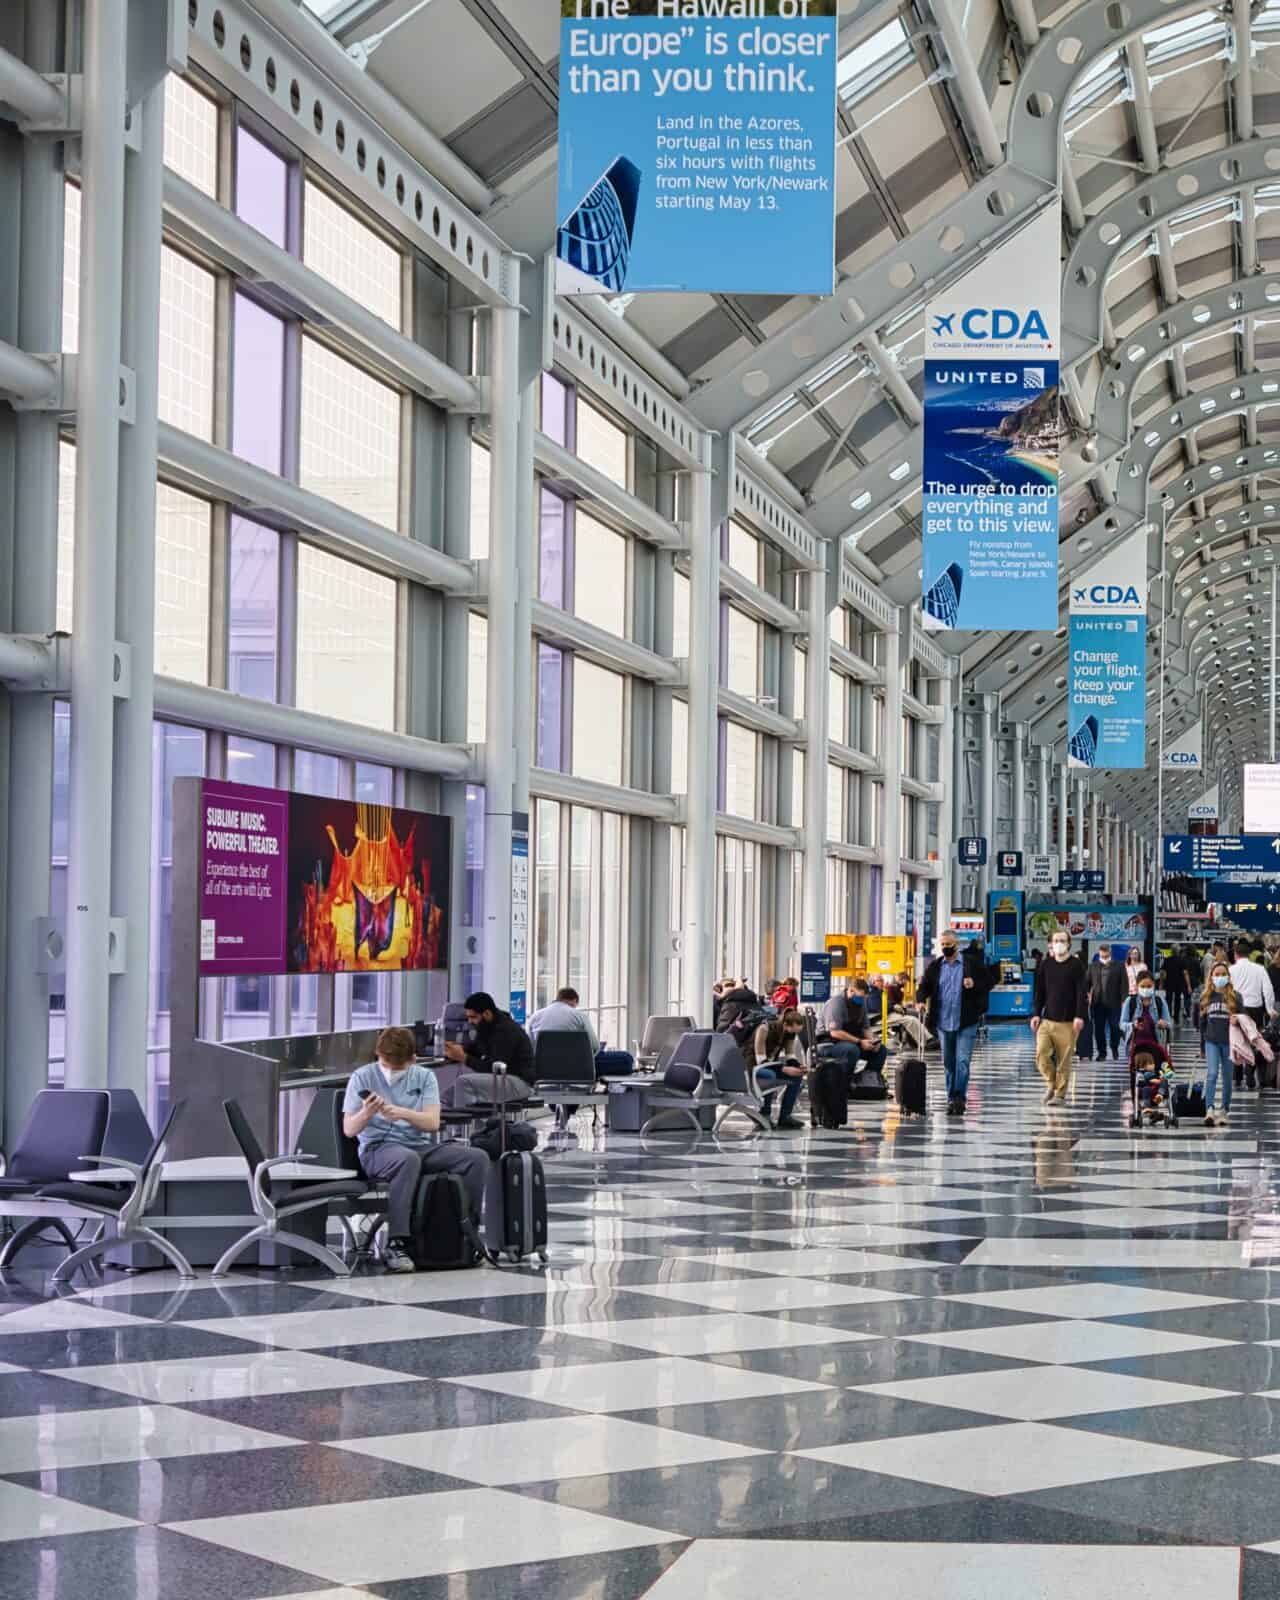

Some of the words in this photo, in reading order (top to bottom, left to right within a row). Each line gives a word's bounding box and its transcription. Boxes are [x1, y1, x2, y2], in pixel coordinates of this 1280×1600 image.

[705, 25, 728, 56] is
[738, 26, 830, 56] closer
[568, 64, 641, 93] than
[652, 67, 713, 96] you
[724, 62, 815, 93] think.
[656, 115, 694, 130] Land
[699, 115, 713, 130] in
[719, 115, 743, 130] the
[747, 115, 804, 132] Azores,
[656, 135, 721, 152] Portugal
[726, 135, 740, 149] in
[745, 135, 774, 150] less
[779, 136, 813, 150] than
[656, 155, 677, 170] six
[682, 155, 726, 170] hours
[731, 156, 763, 170] with
[769, 155, 816, 172] flights
[656, 175, 691, 189] from
[695, 176, 728, 190] New
[732, 175, 829, 191] York/Newark
[655, 195, 714, 210] starting
[719, 196, 751, 211] May
[758, 196, 779, 210] 13.
[961, 308, 1049, 340] CDA
[935, 372, 1018, 383] UNITED
[927, 481, 956, 497] The
[960, 485, 995, 498] urge
[1000, 483, 1016, 497] to
[1020, 482, 1057, 498] drop
[927, 499, 1014, 516] everything
[1018, 500, 1047, 514] and
[927, 518, 952, 534] get
[957, 518, 973, 532] to
[979, 518, 1008, 532] this
[1012, 518, 1055, 532] view.
[1090, 585, 1139, 604] CDA
[1073, 650, 1118, 664] Change
[1073, 665, 1102, 677] your
[1106, 664, 1141, 678] flight.
[1073, 680, 1103, 692] Keep
[1107, 681, 1135, 693] your
[1073, 693, 1117, 706] change.
[1170, 753, 1199, 763] CDA
[1195, 806, 1216, 815] CDA
[206, 807, 239, 829] SUBLIME
[240, 811, 267, 832] MUSIC.
[206, 830, 247, 852] POWERFUL
[247, 836, 280, 855] THEATER.
[206, 860, 239, 878] Experience
[239, 862, 249, 877] the
[249, 864, 259, 878] best
[260, 864, 269, 879] of
[205, 880, 213, 895] all
